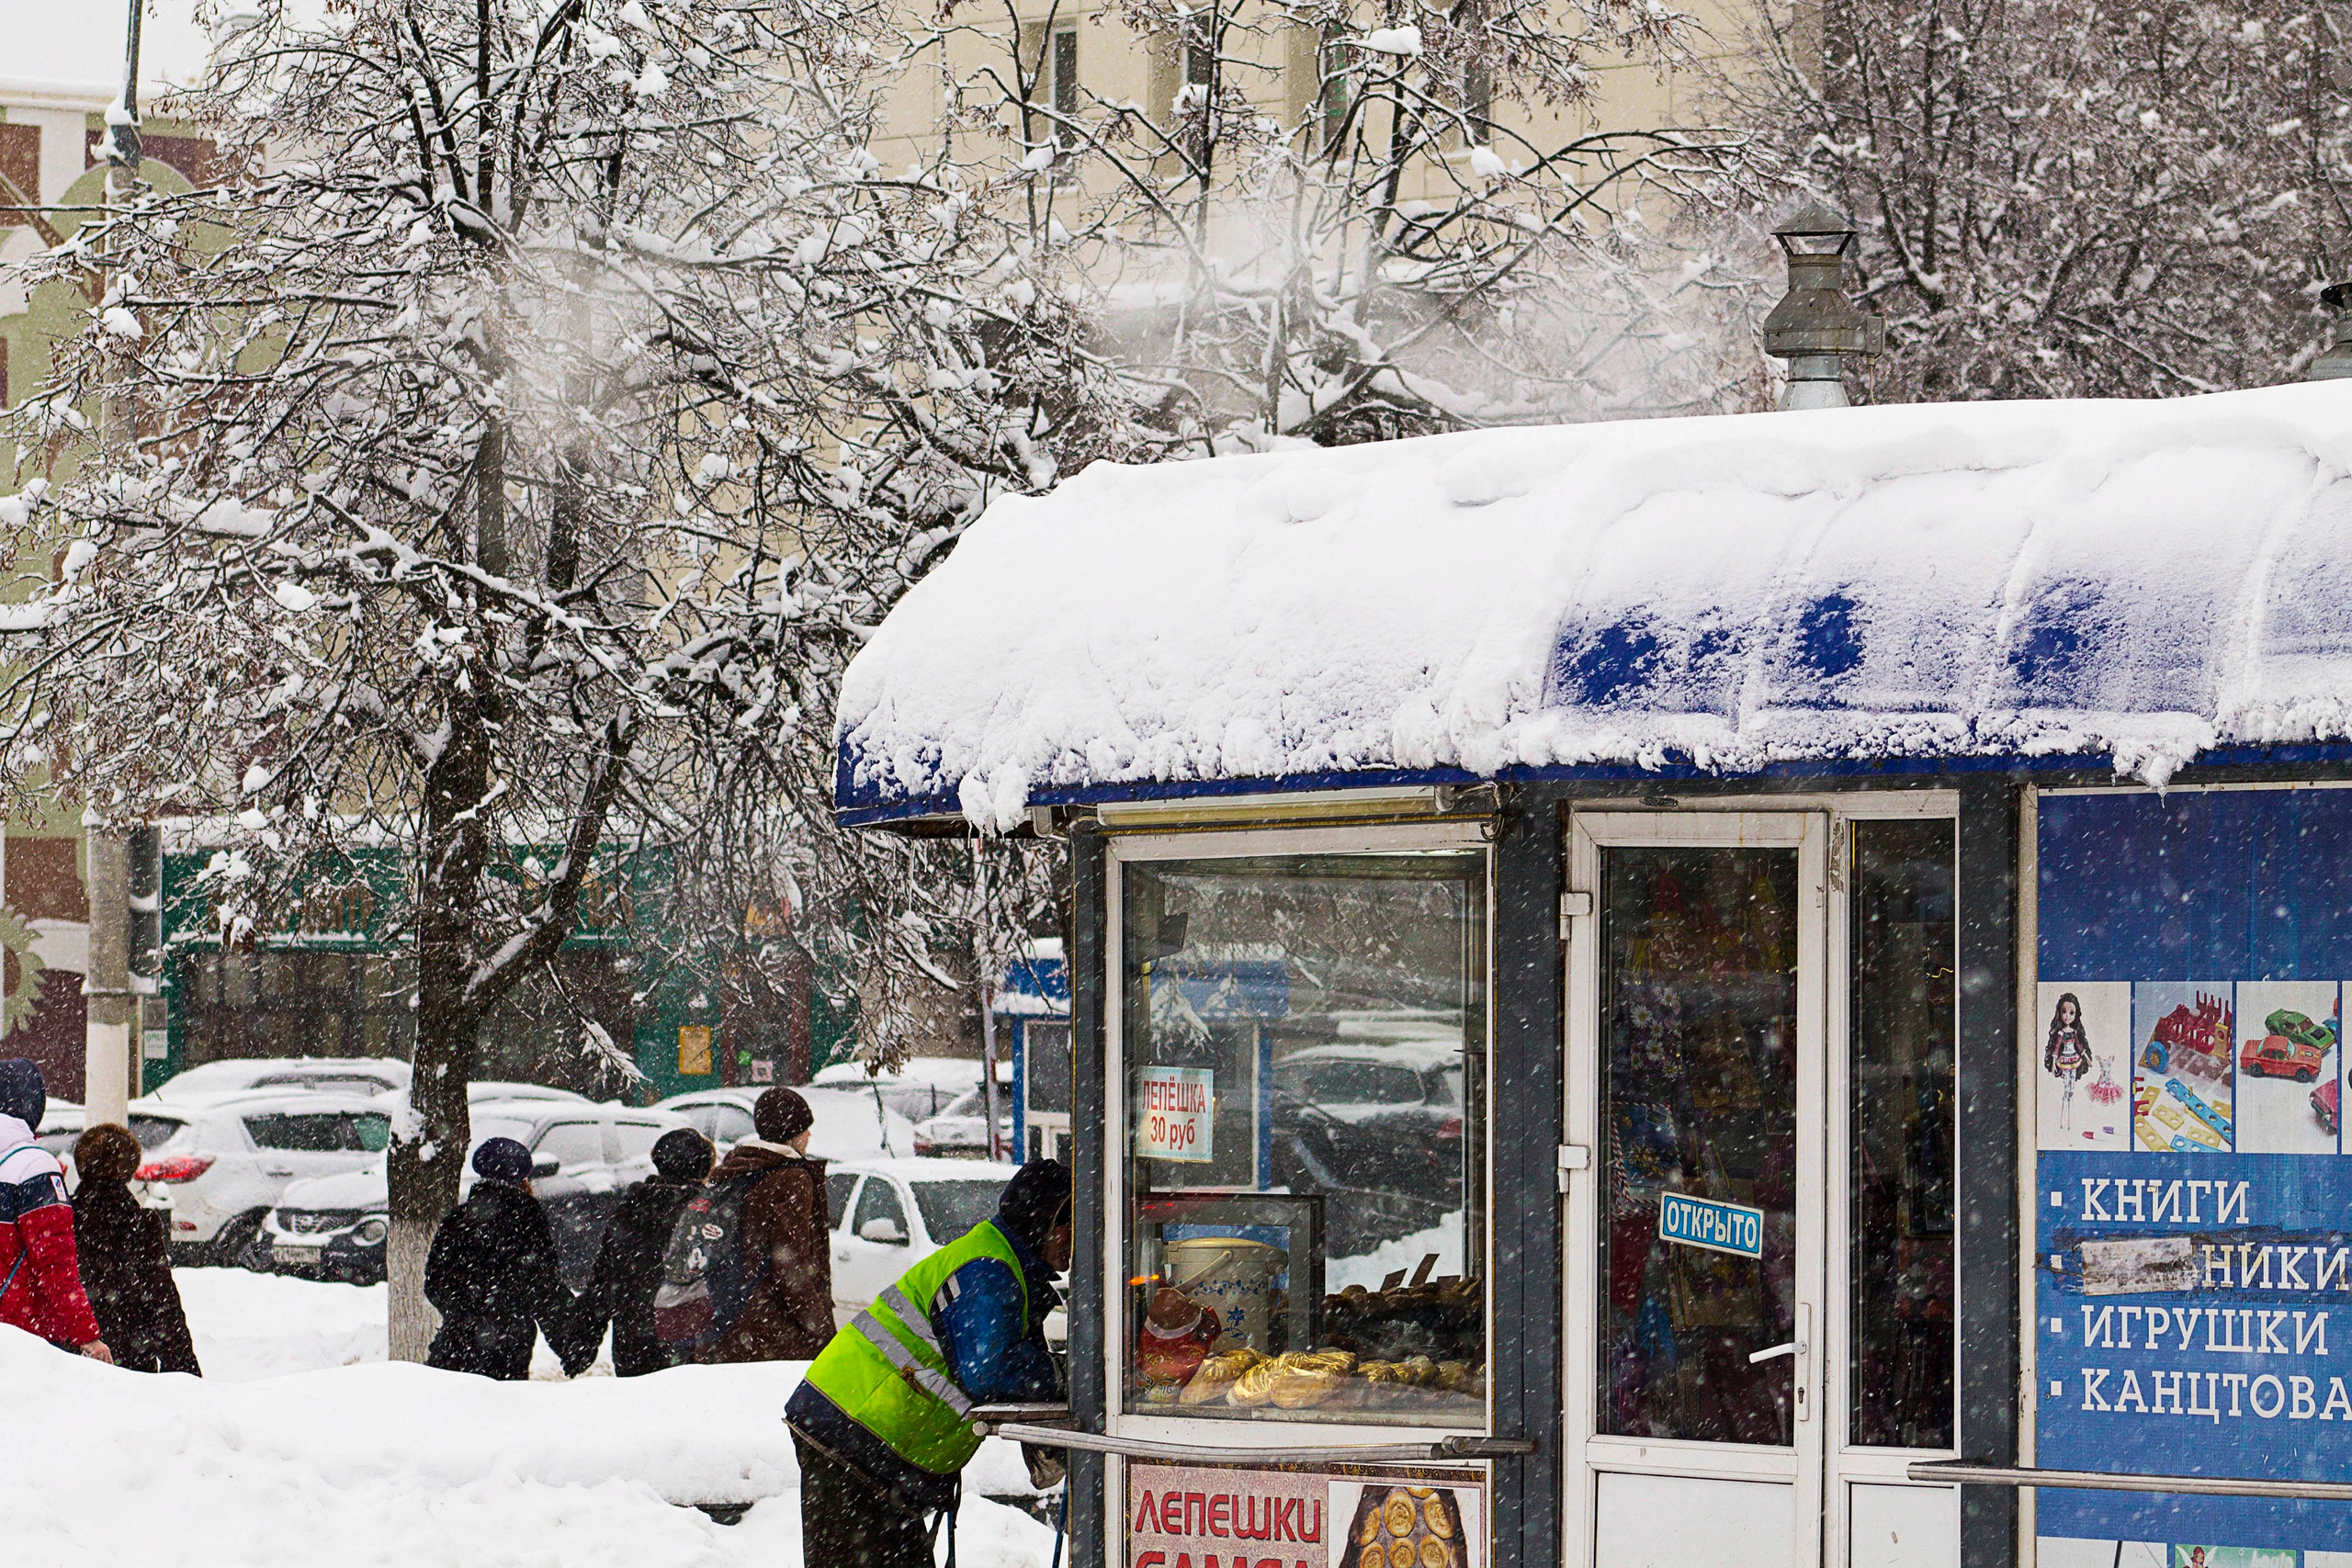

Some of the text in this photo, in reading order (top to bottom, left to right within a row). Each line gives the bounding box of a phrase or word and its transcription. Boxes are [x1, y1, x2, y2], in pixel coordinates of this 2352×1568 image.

[1142, 1076, 1206, 1114] ЛЕПЁШКА
[1150, 1116, 1195, 1150] 30 руб
[1667, 1201, 1757, 1248] ОТКРЫТО
[2081, 1178, 2251, 1224] КНИГИ
[2081, 1304, 2329, 1355] ИГРУШКИ
[2081, 1368, 2352, 1425] КАНЦТОВА
[1135, 1489, 1322, 1544] ЛЕПЕШКИ
